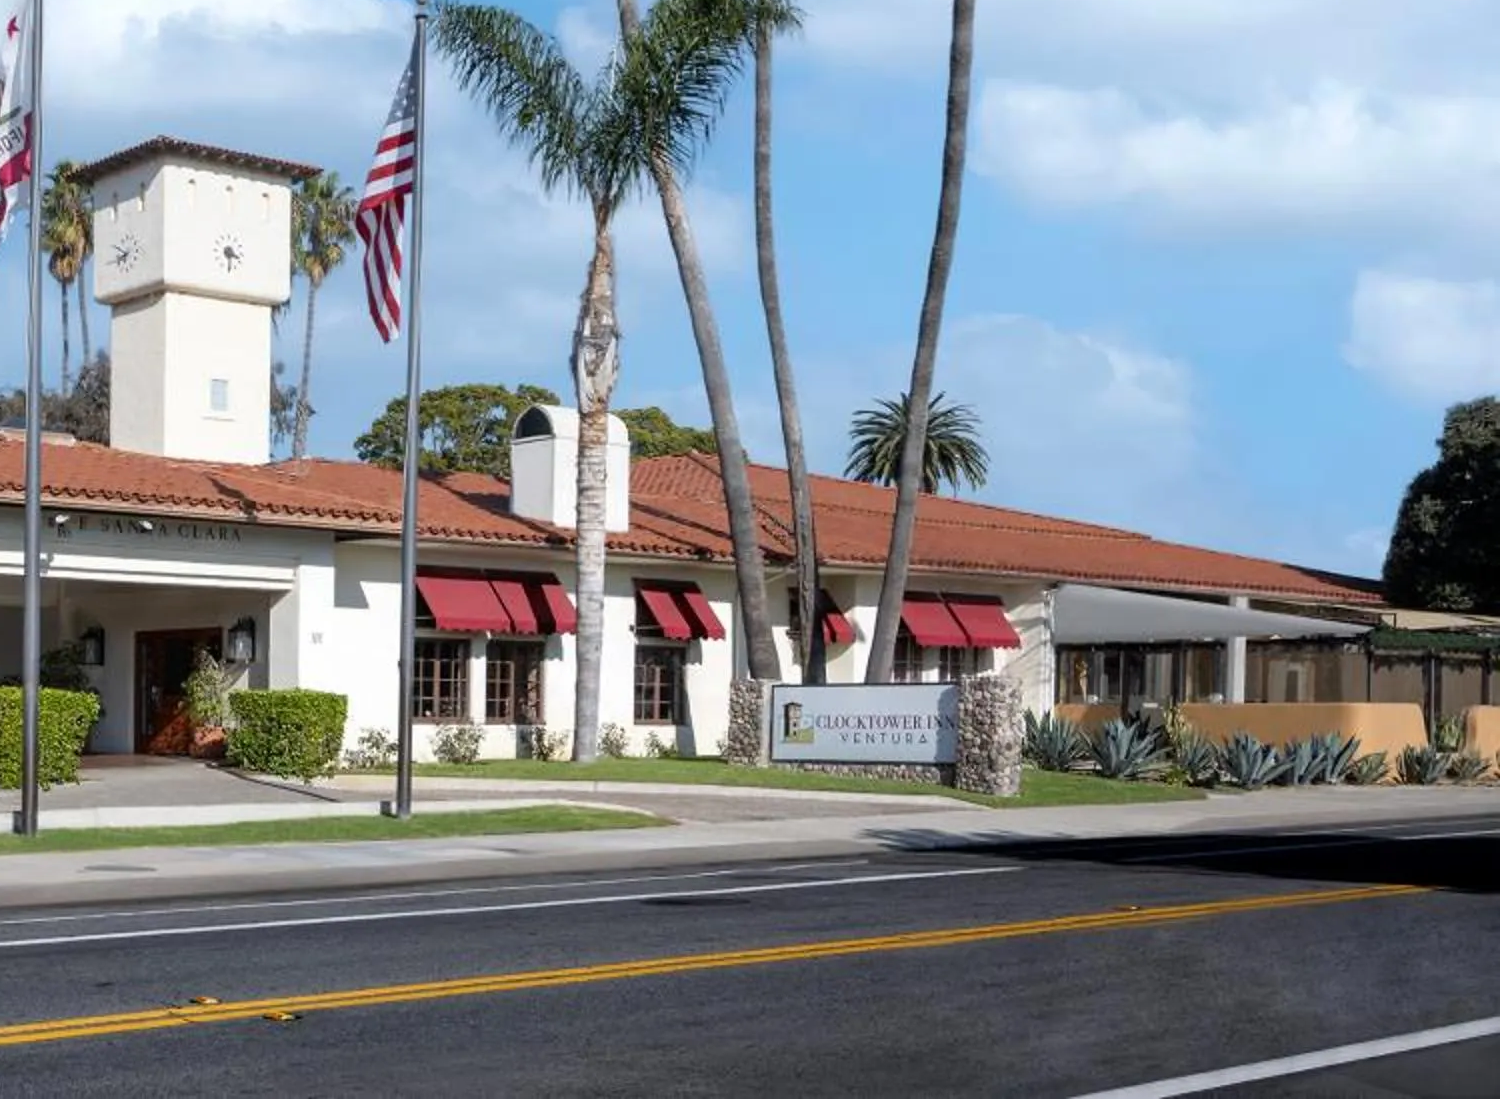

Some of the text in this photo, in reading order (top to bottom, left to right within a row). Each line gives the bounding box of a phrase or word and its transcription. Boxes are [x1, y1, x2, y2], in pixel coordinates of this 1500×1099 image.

[102, 519, 168, 536] SANA
[178, 525, 241, 542] CLARA
[815, 713, 956, 730] CLOCKTOWER INN
[840, 732, 928, 744] VENTURA
